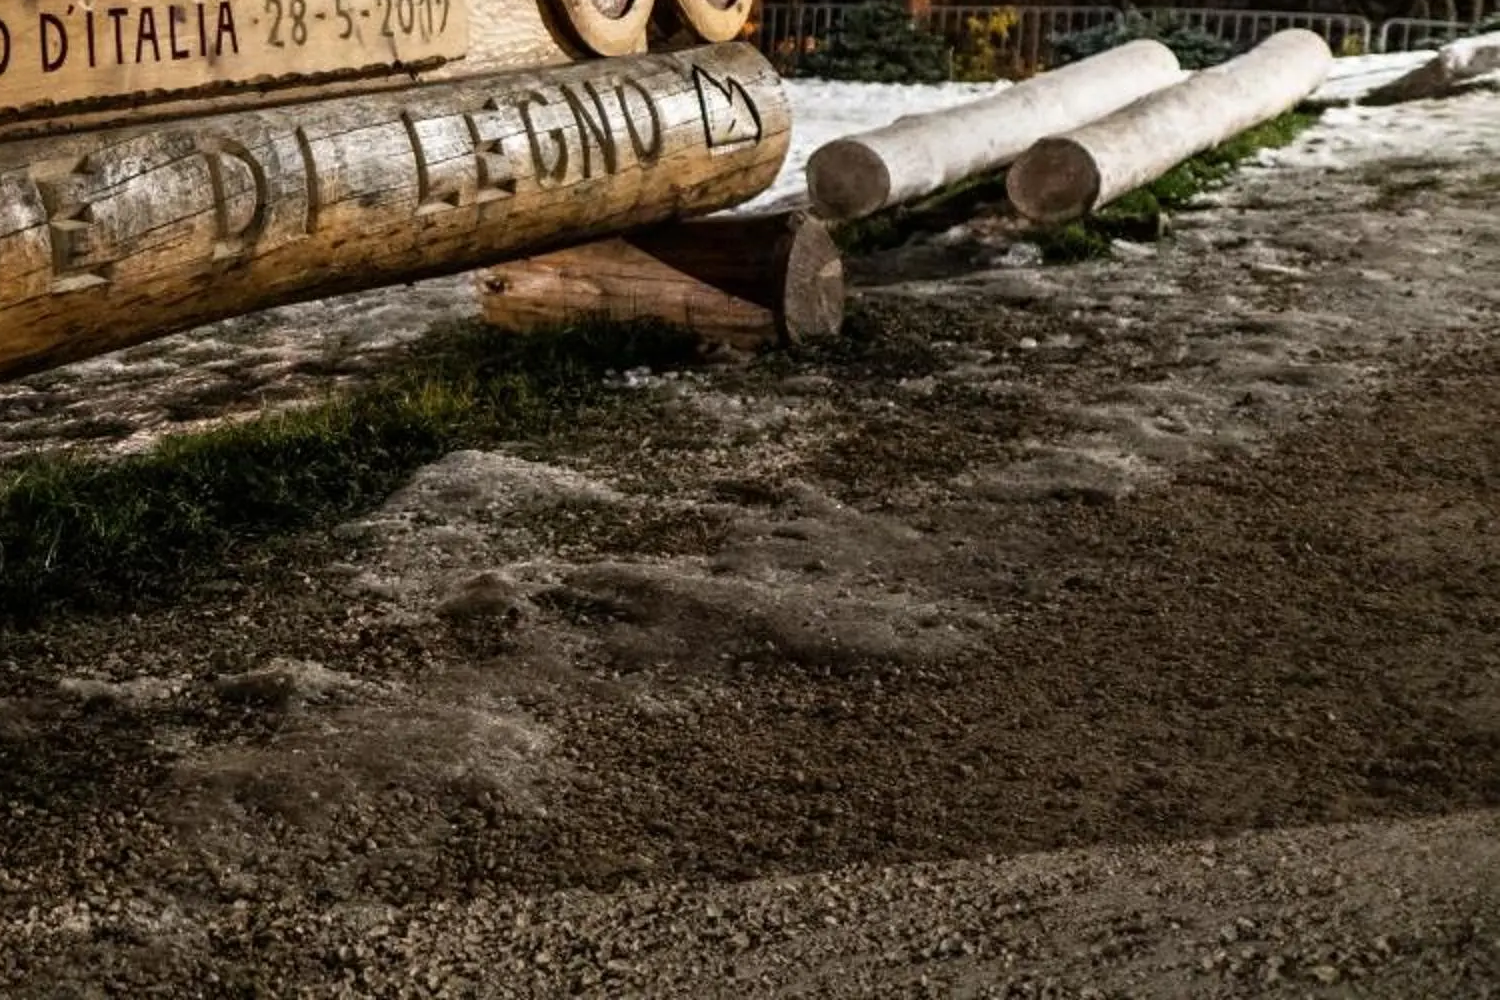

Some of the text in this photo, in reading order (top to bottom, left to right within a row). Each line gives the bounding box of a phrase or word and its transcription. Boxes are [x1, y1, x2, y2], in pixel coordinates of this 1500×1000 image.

[39, 1, 240, 73] D'ITALIA
[200, 124, 320, 260] DI
[400, 76, 663, 217] LEGNO
